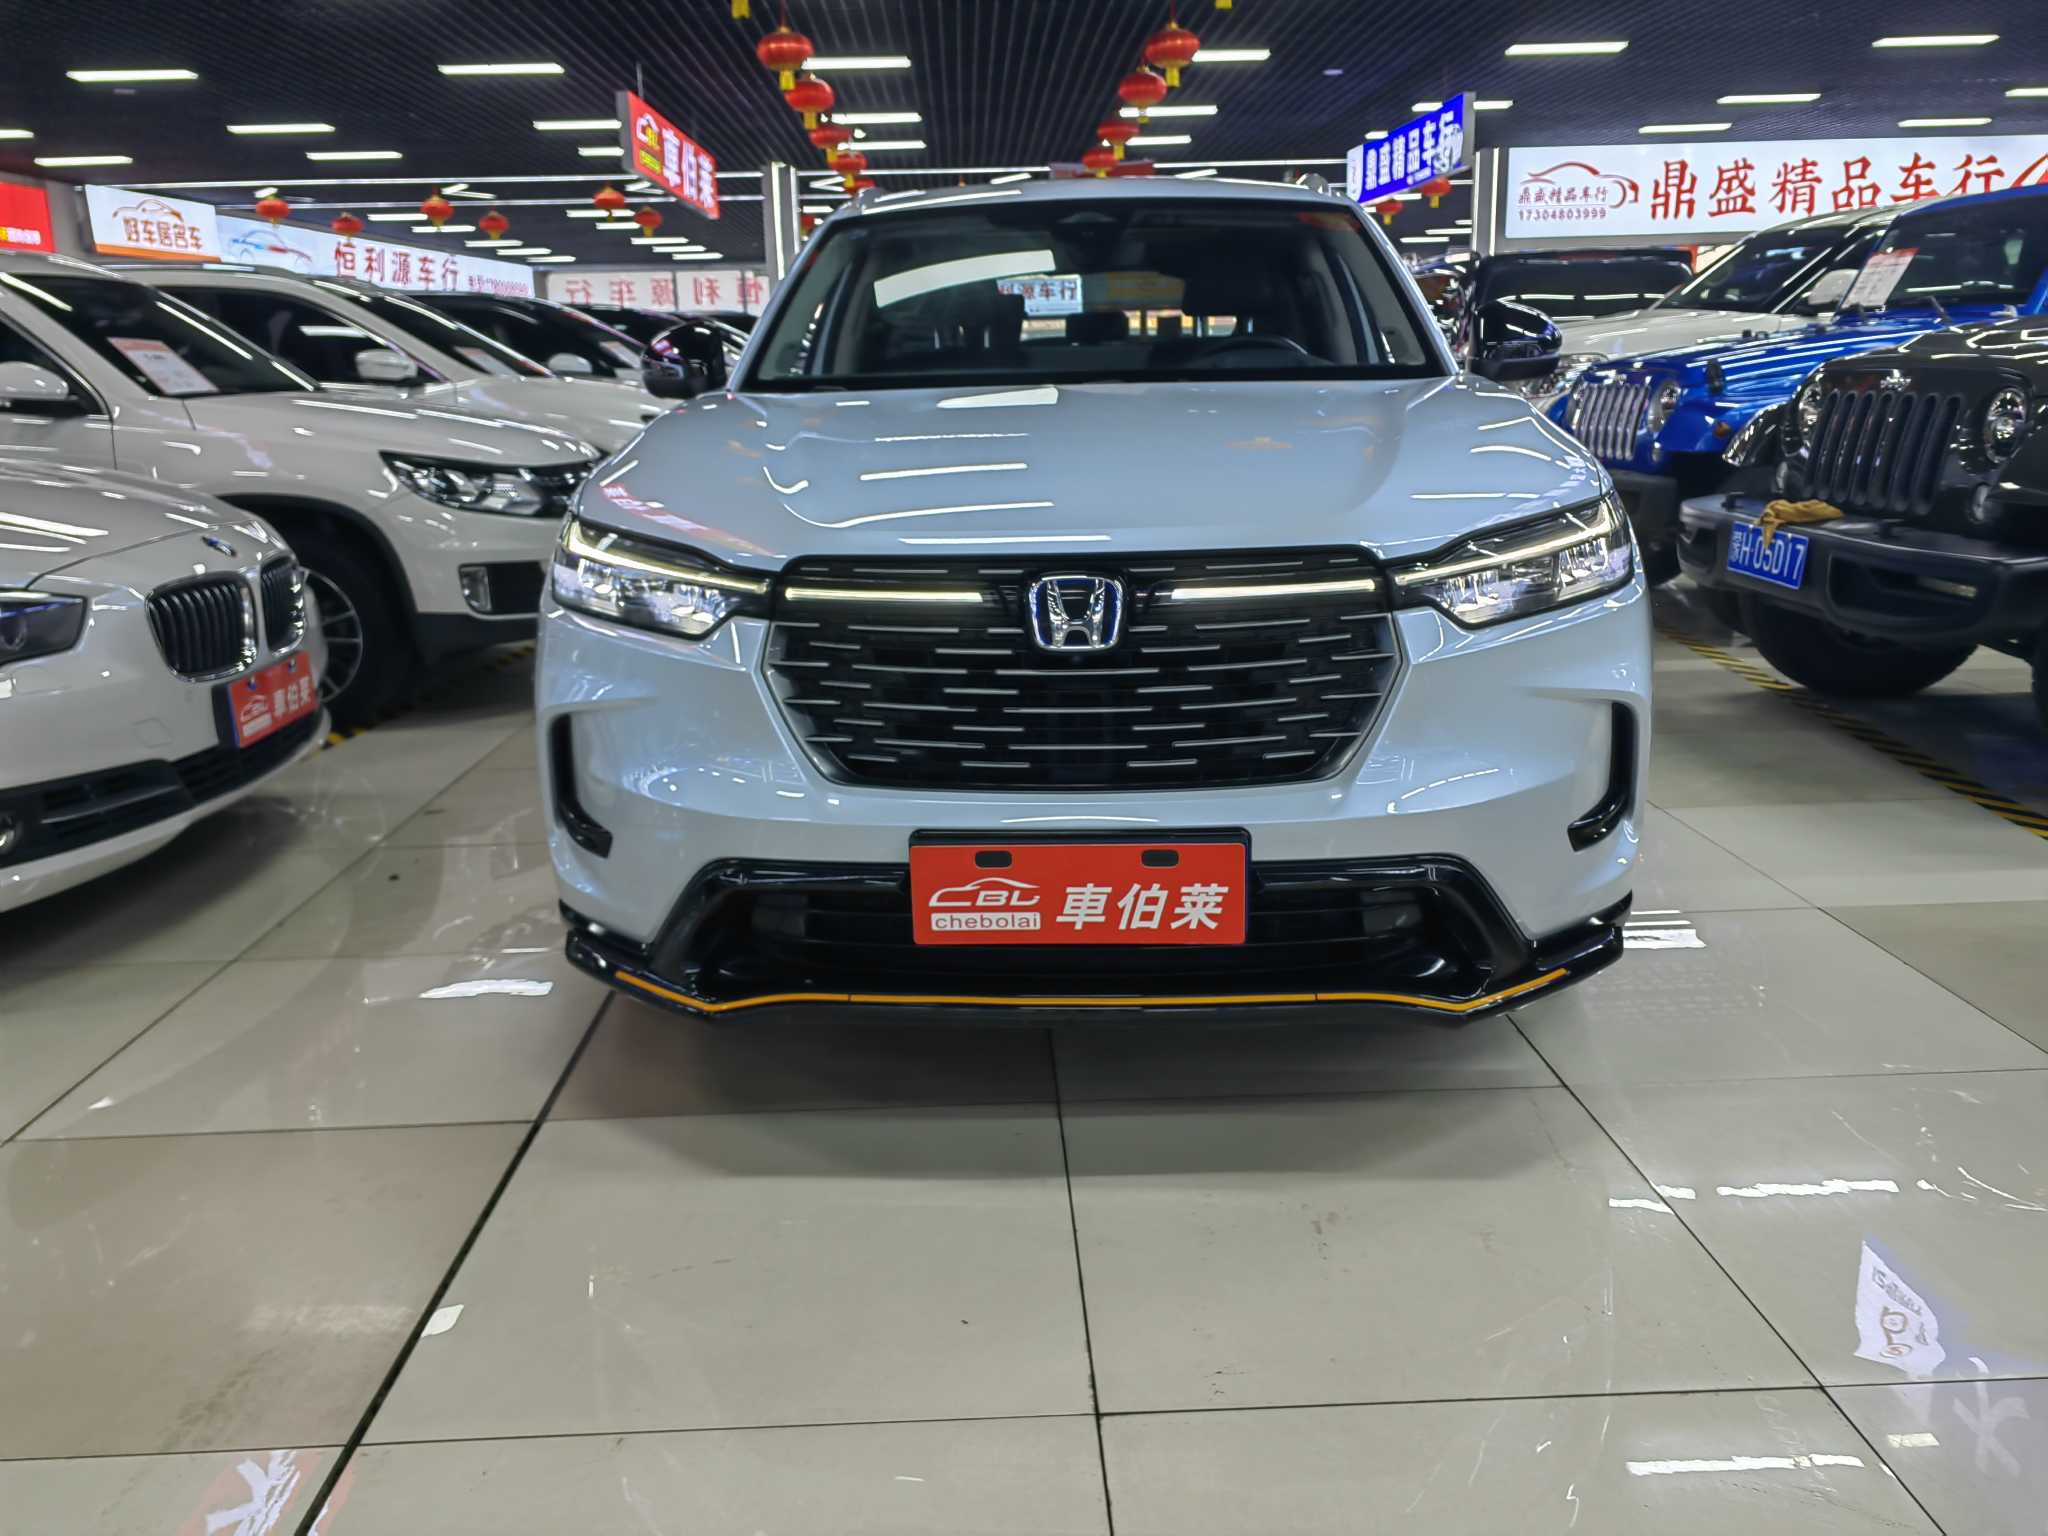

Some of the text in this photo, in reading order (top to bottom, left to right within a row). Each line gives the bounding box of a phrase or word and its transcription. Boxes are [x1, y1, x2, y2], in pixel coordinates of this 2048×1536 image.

[1651, 151, 2005, 220] 鼎盛精品车行
[334, 241, 460, 292] 恒利源车行
[934, 913, 1038, 930] chebolai
[1056, 883, 1229, 931] 車伯莱
